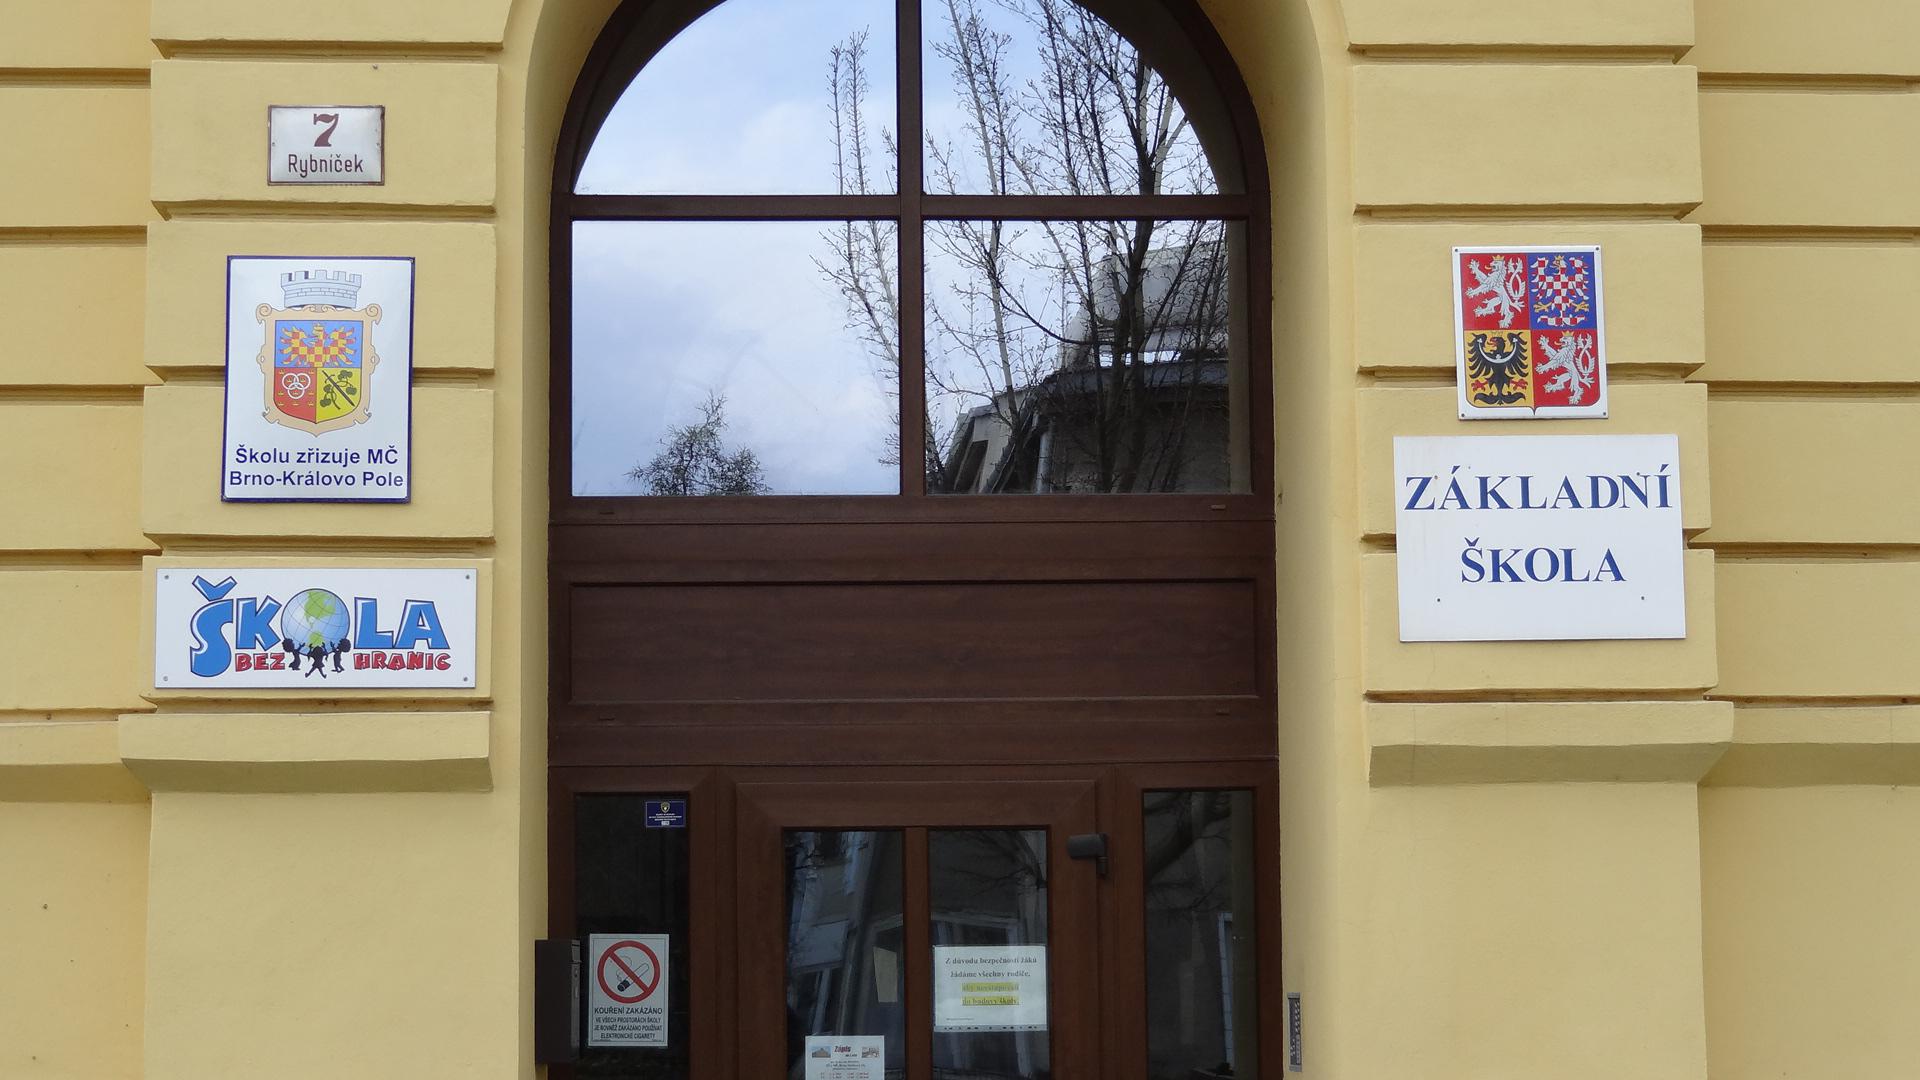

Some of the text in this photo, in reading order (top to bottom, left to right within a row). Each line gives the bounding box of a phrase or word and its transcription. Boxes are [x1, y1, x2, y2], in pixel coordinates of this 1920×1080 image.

[313, 113, 339, 147] 7
[288, 154, 363, 178] Rybníček
[235, 444, 398, 467] Školu zřizuje MČ
[230, 470, 404, 487] Brno-Královo Pole
[1404, 463, 1673, 511] ZÁKLADNÍ
[1461, 537, 1627, 583] ŠKOLA
[190, 575, 450, 678] ŠKOLA
[235, 651, 452, 672] BEZ HRANIC
[594, 1006, 662, 1014] KOUŘENÍ ZAKÁZÁNO
